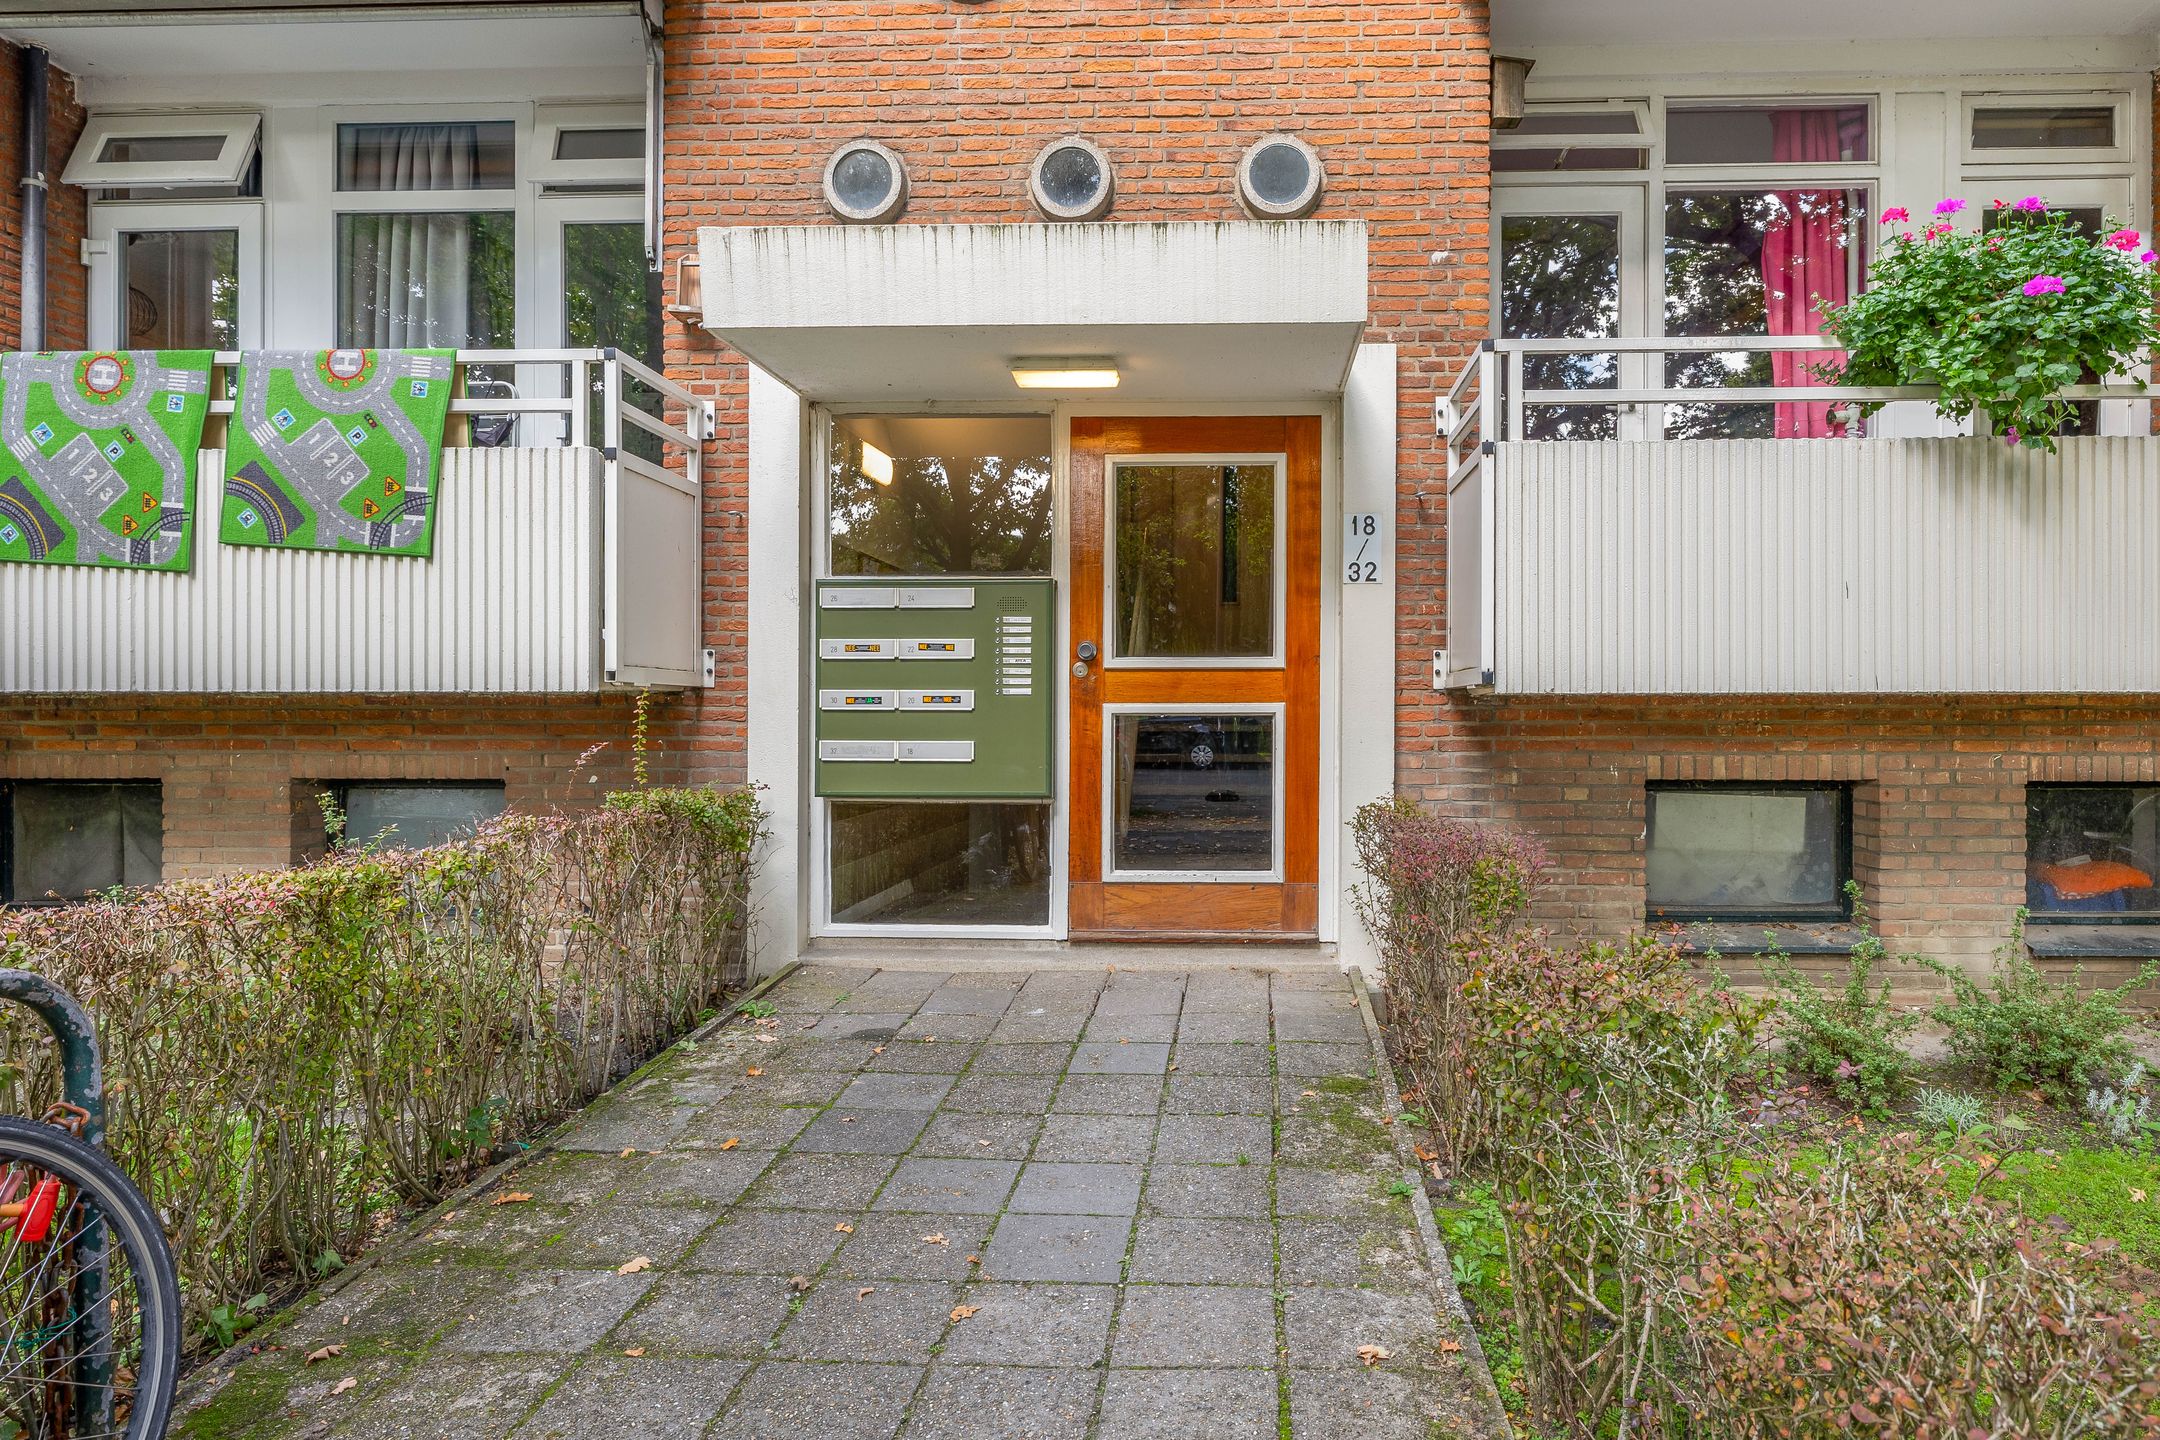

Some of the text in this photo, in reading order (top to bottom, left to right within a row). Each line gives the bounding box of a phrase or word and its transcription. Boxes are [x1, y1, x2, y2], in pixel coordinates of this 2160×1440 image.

[353, 431, 362, 442] P
[109, 446, 119, 456] P
[308, 432, 355, 486] 1 2 3
[67, 448, 114, 502] 1 2 3
[1351, 515, 1376, 536] 18
[1348, 561, 1377, 582] 32
